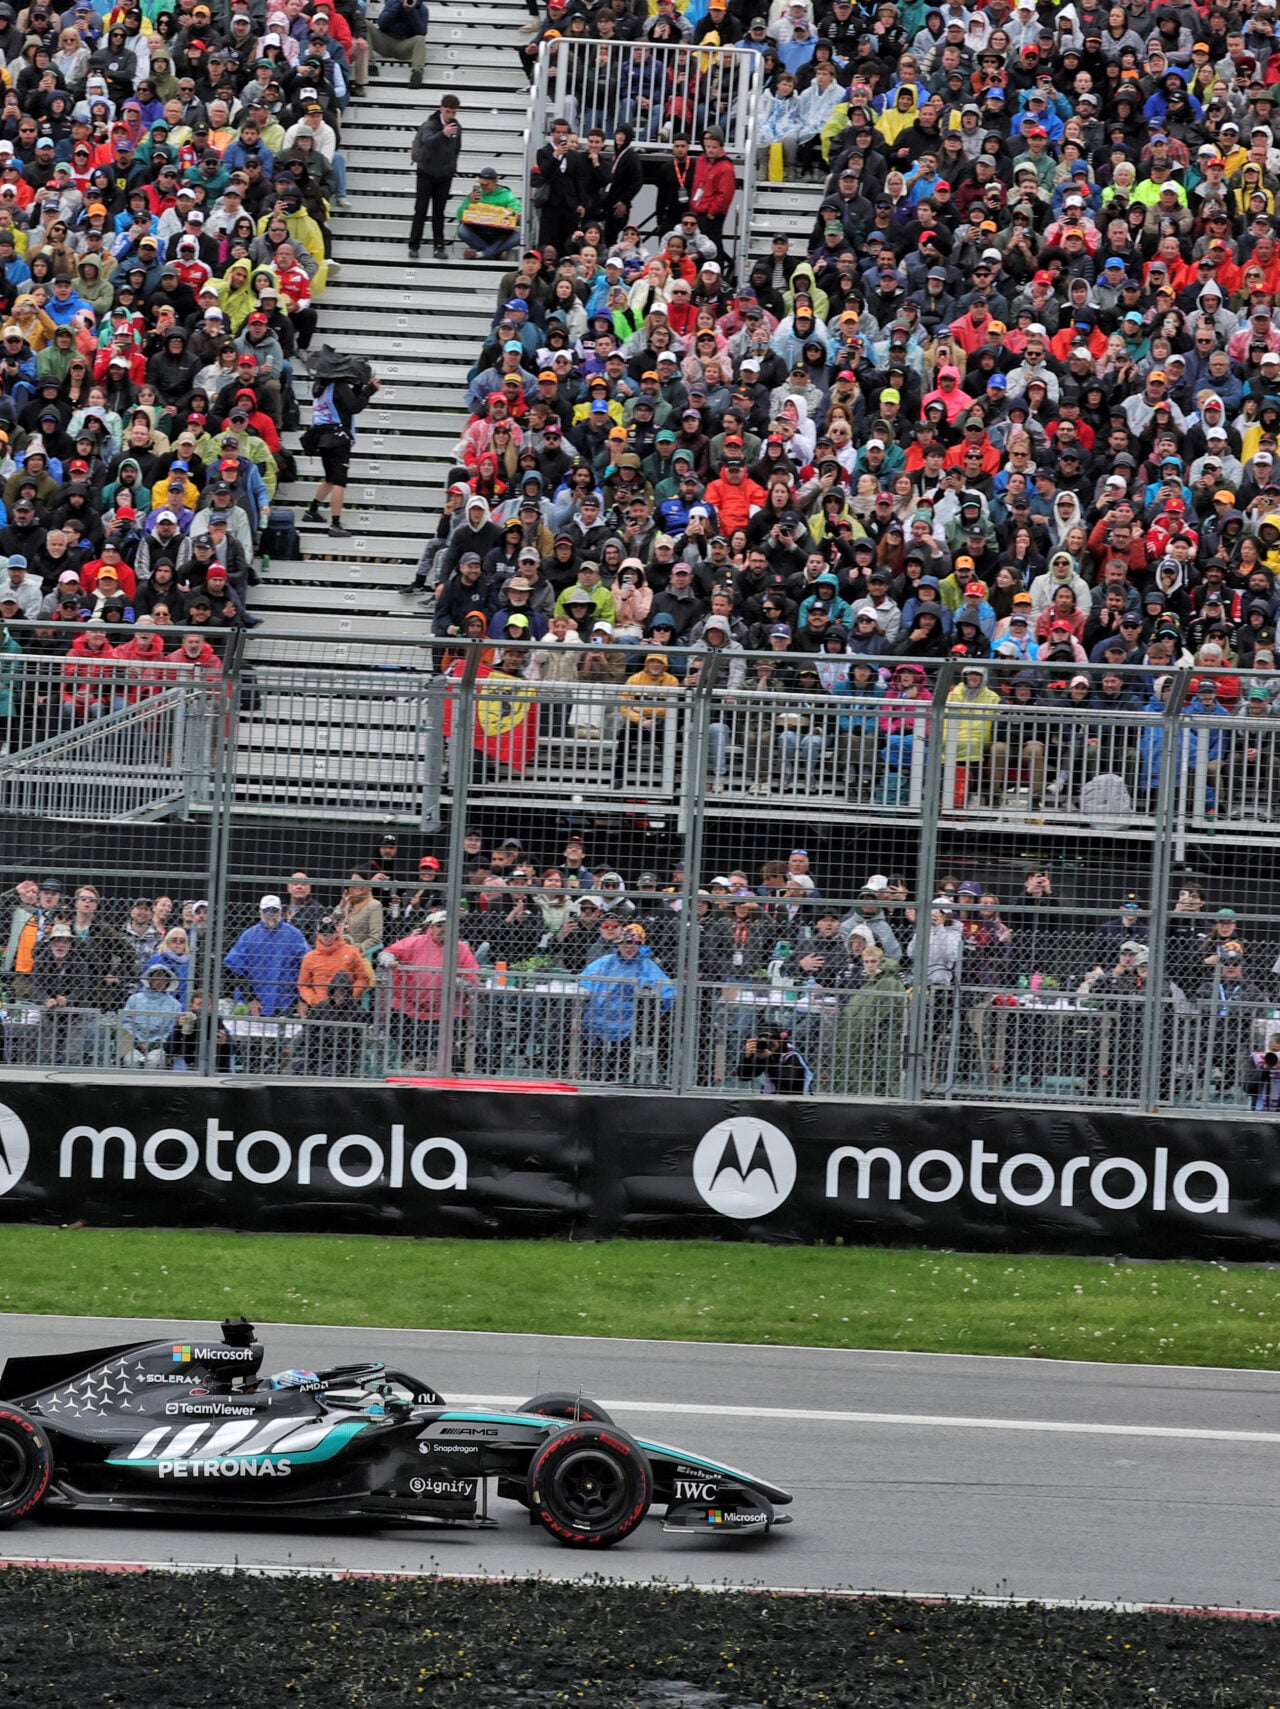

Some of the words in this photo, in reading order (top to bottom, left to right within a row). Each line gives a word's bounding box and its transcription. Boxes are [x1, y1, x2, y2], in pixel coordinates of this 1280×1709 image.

[58, 1117, 468, 1191] motorola
[825, 1138, 1230, 1214] motorola
[194, 1348, 253, 1361] Microsoft
[146, 1374, 192, 1384] SOLERA
[299, 1382, 321, 1393] AMD
[180, 1403, 255, 1416] TeamViewer
[459, 1428, 499, 1436] AMG
[433, 1443, 479, 1454] Snapdragon
[158, 1458, 292, 1479] PETRONAS
[675, 1481, 718, 1501] IWC
[724, 1512, 768, 1522] Microsoft
